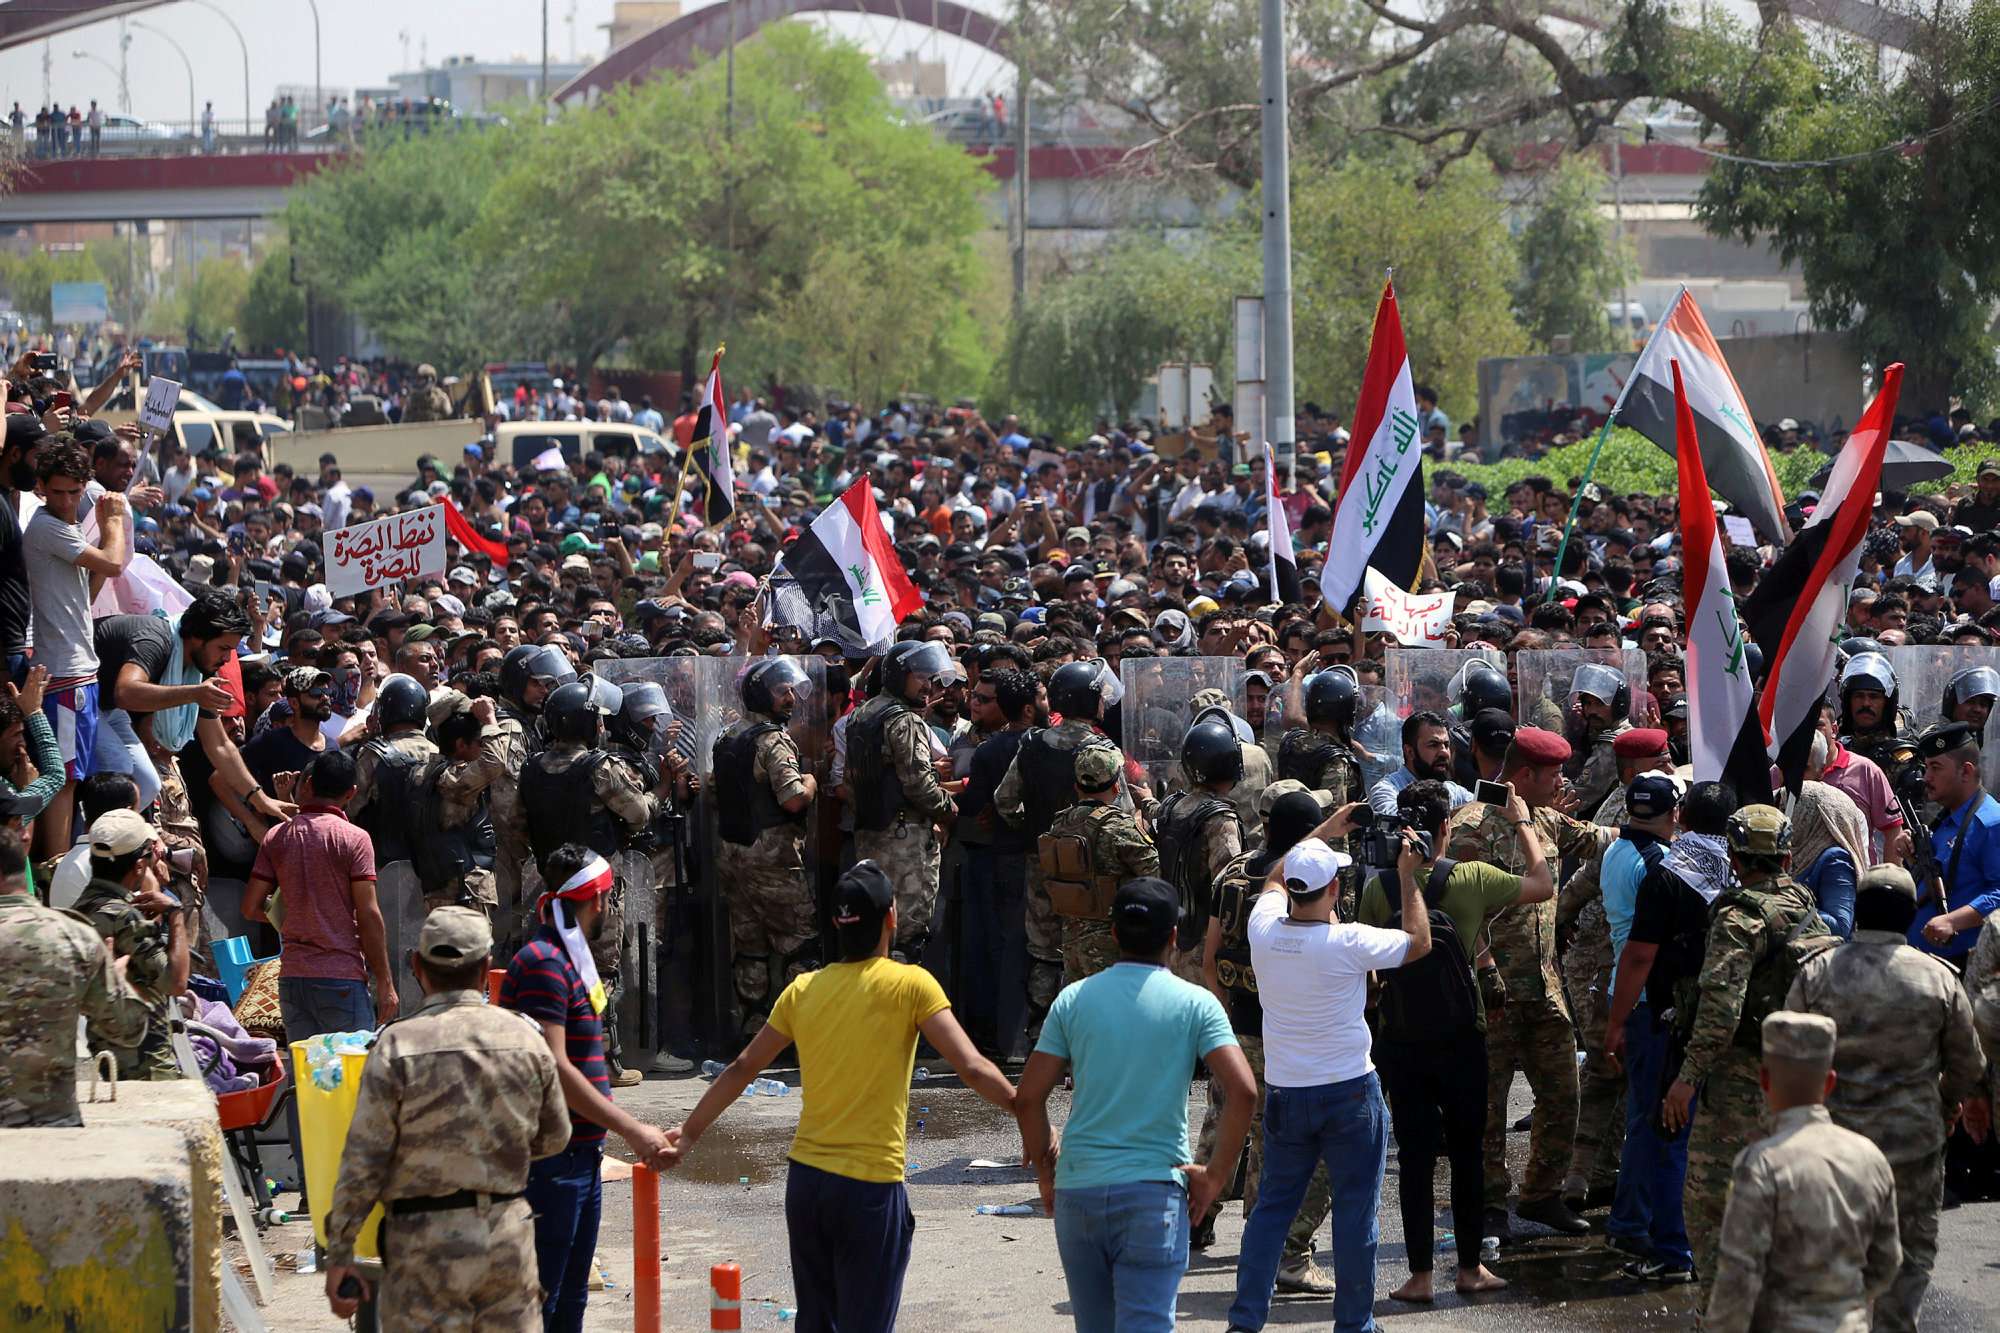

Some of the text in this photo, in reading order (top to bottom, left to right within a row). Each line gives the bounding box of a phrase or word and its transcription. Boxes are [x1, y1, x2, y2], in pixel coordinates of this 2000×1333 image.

[334, 511, 436, 567] نفط البصرة
[360, 548, 421, 586] للبصرة
